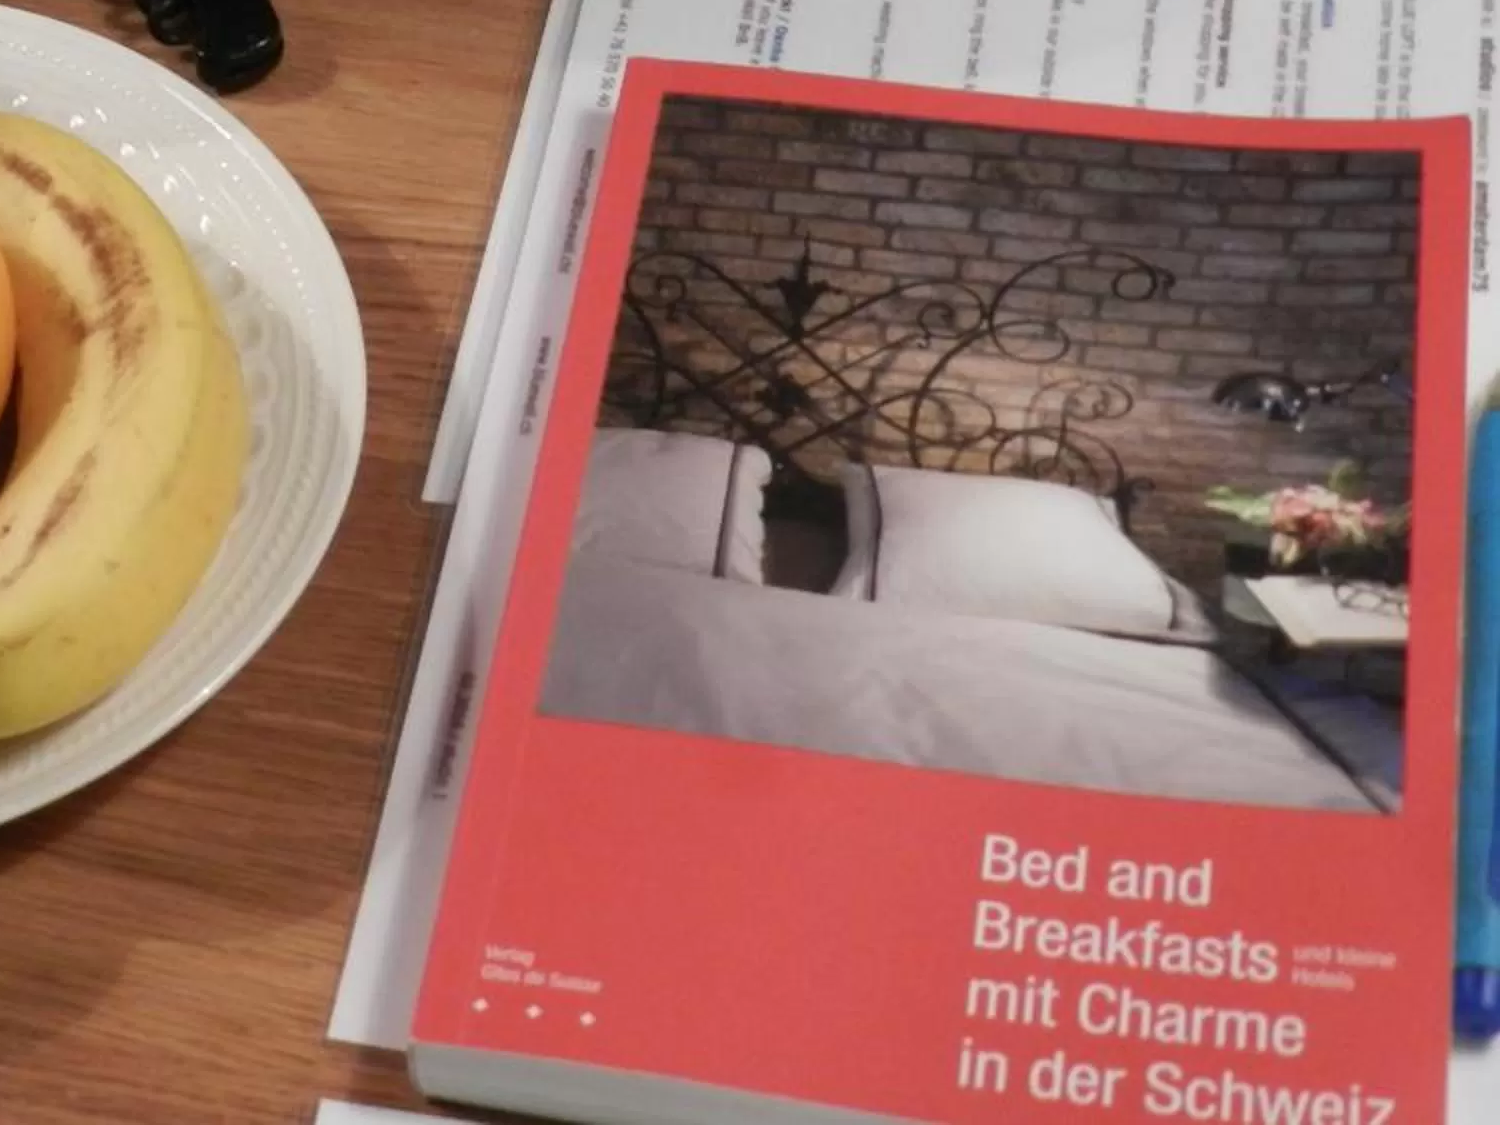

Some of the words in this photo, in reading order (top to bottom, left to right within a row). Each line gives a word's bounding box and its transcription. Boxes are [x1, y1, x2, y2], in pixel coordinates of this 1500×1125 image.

[980, 834, 1090, 893] Bed
[1107, 858, 1213, 908] and
[973, 899, 1279, 983] Breakfasts
[965, 973, 1059, 1028] mit
[1077, 982, 1308, 1057] Charme
[956, 1036, 1010, 1094] in
[1028, 1049, 1127, 1108] der
[1143, 1062, 1397, 1125] Schweiz
